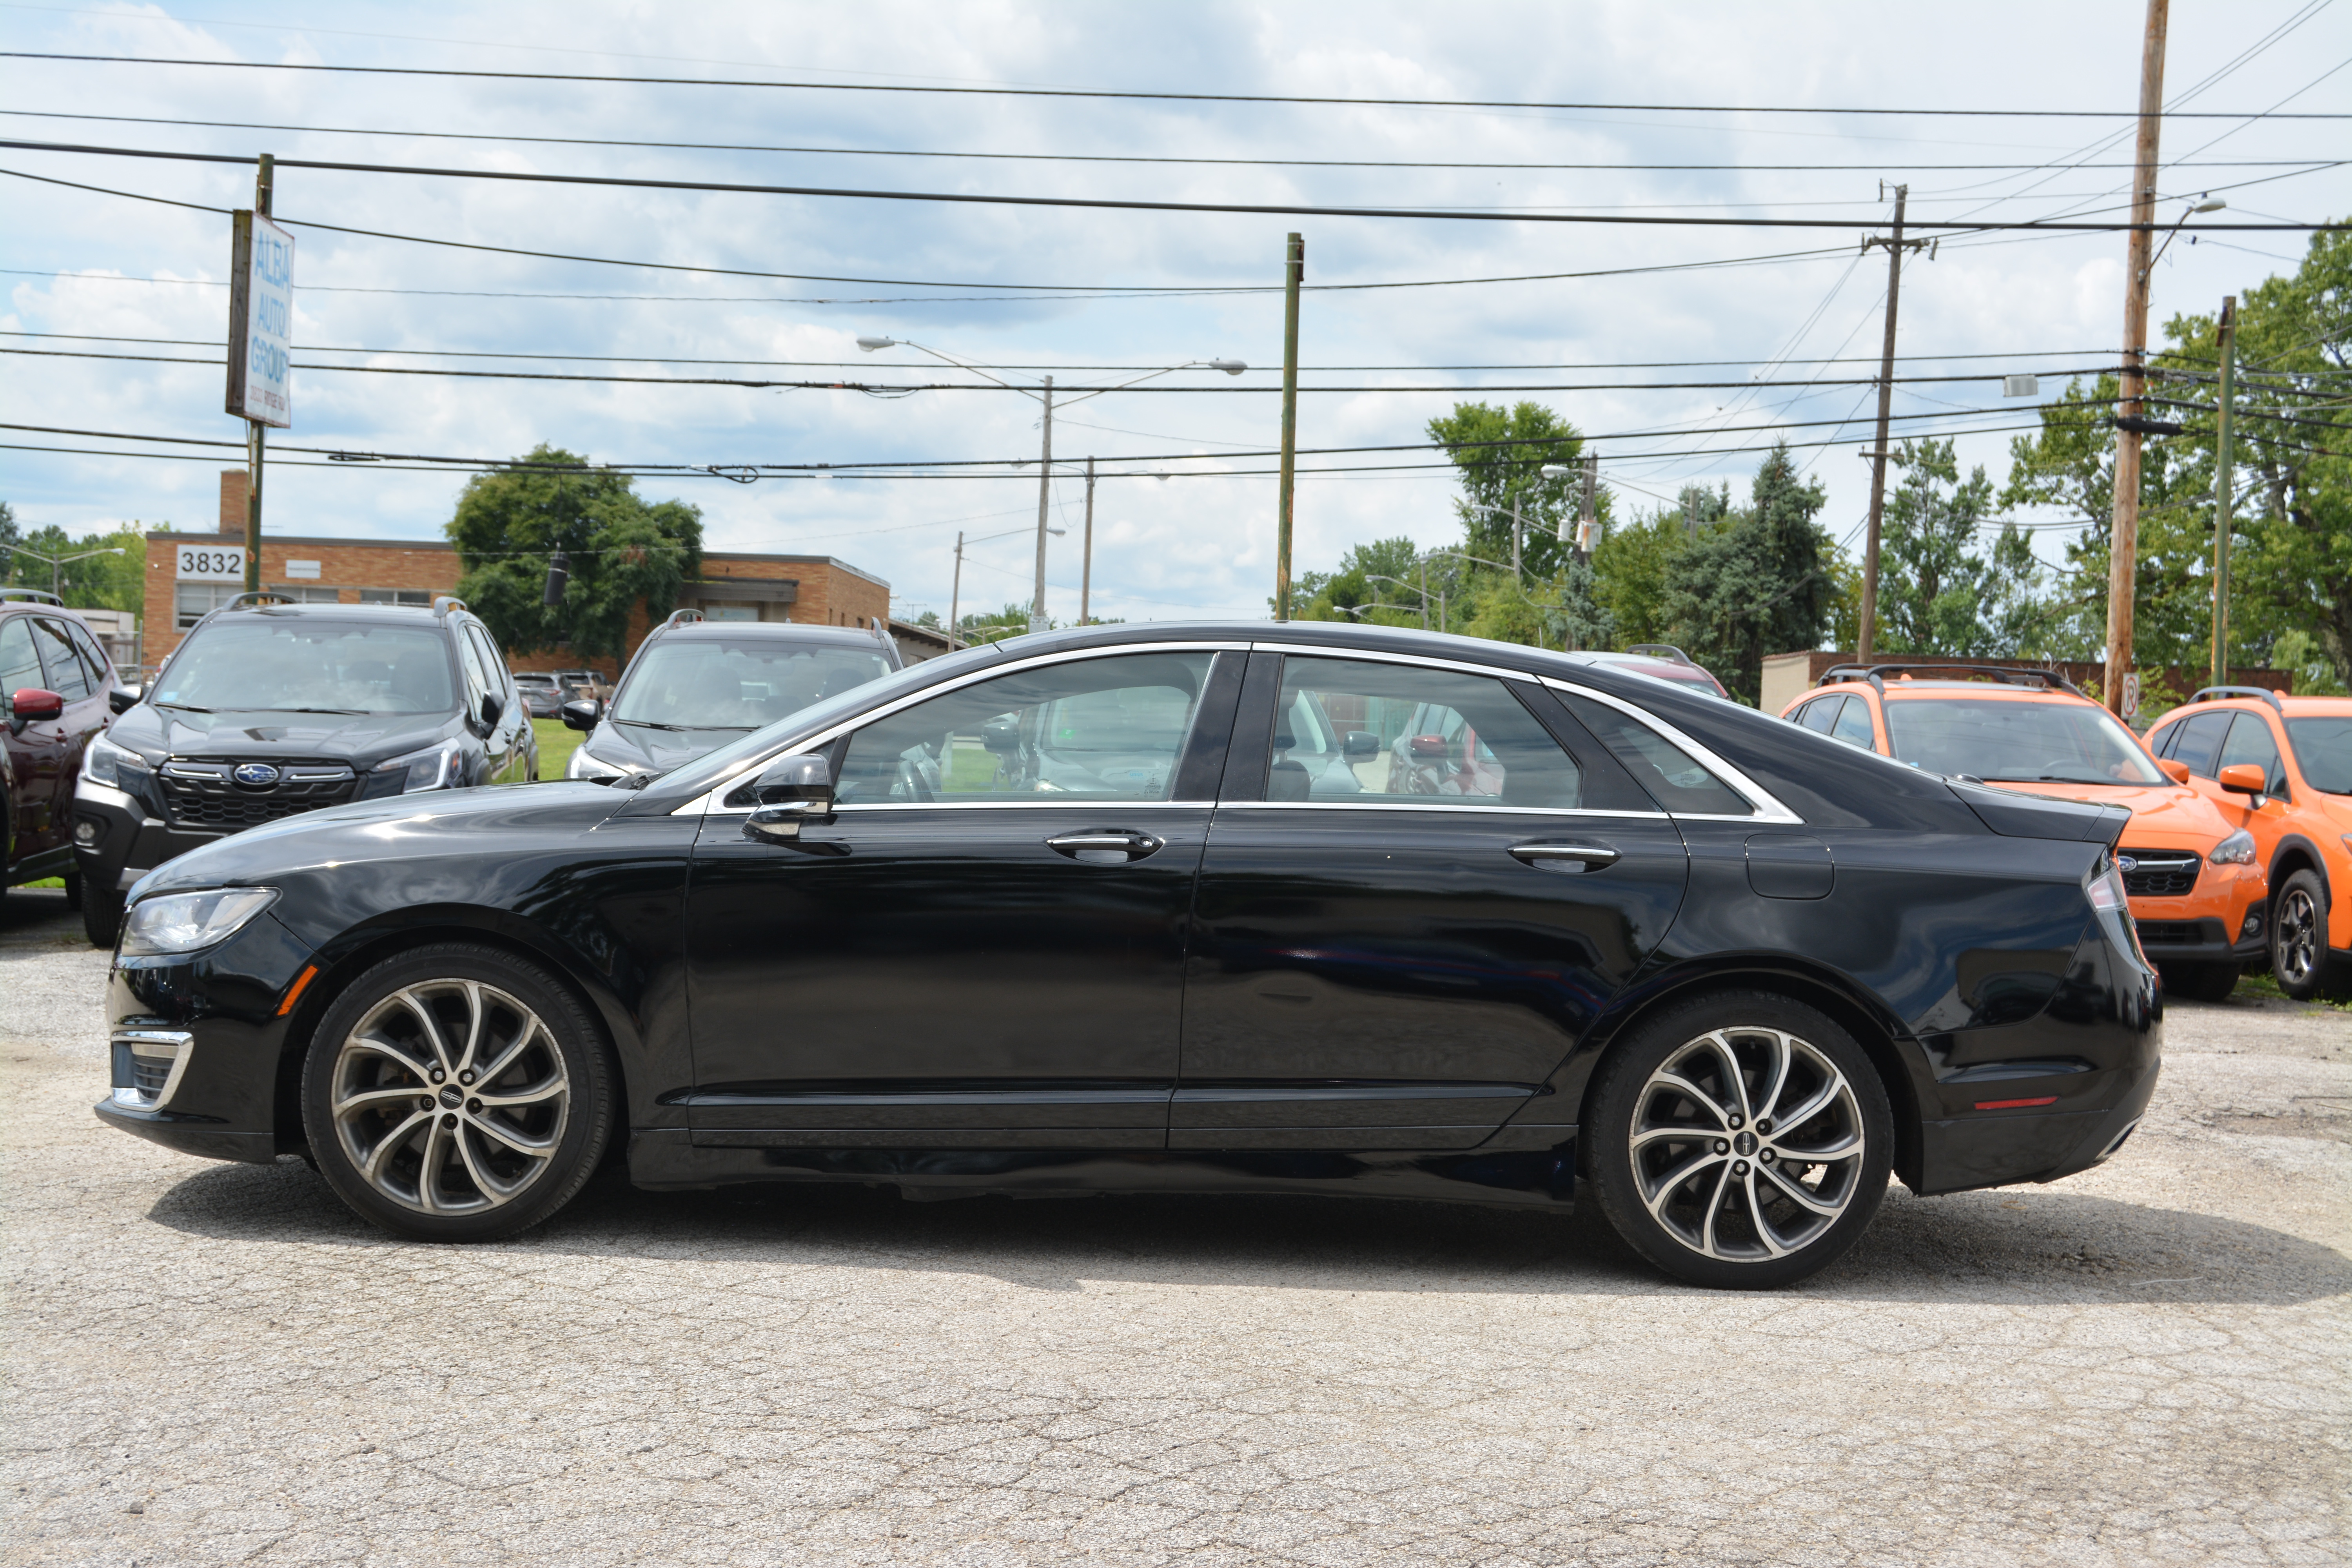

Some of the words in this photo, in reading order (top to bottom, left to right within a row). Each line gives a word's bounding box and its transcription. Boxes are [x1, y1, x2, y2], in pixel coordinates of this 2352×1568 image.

[255, 230, 290, 293] ALBA
[258, 292, 286, 338] AUTO
[251, 335, 288, 384] GROUP
[181, 552, 240, 573] 3832
[556, 1018, 587, 1085] MICHELIN
